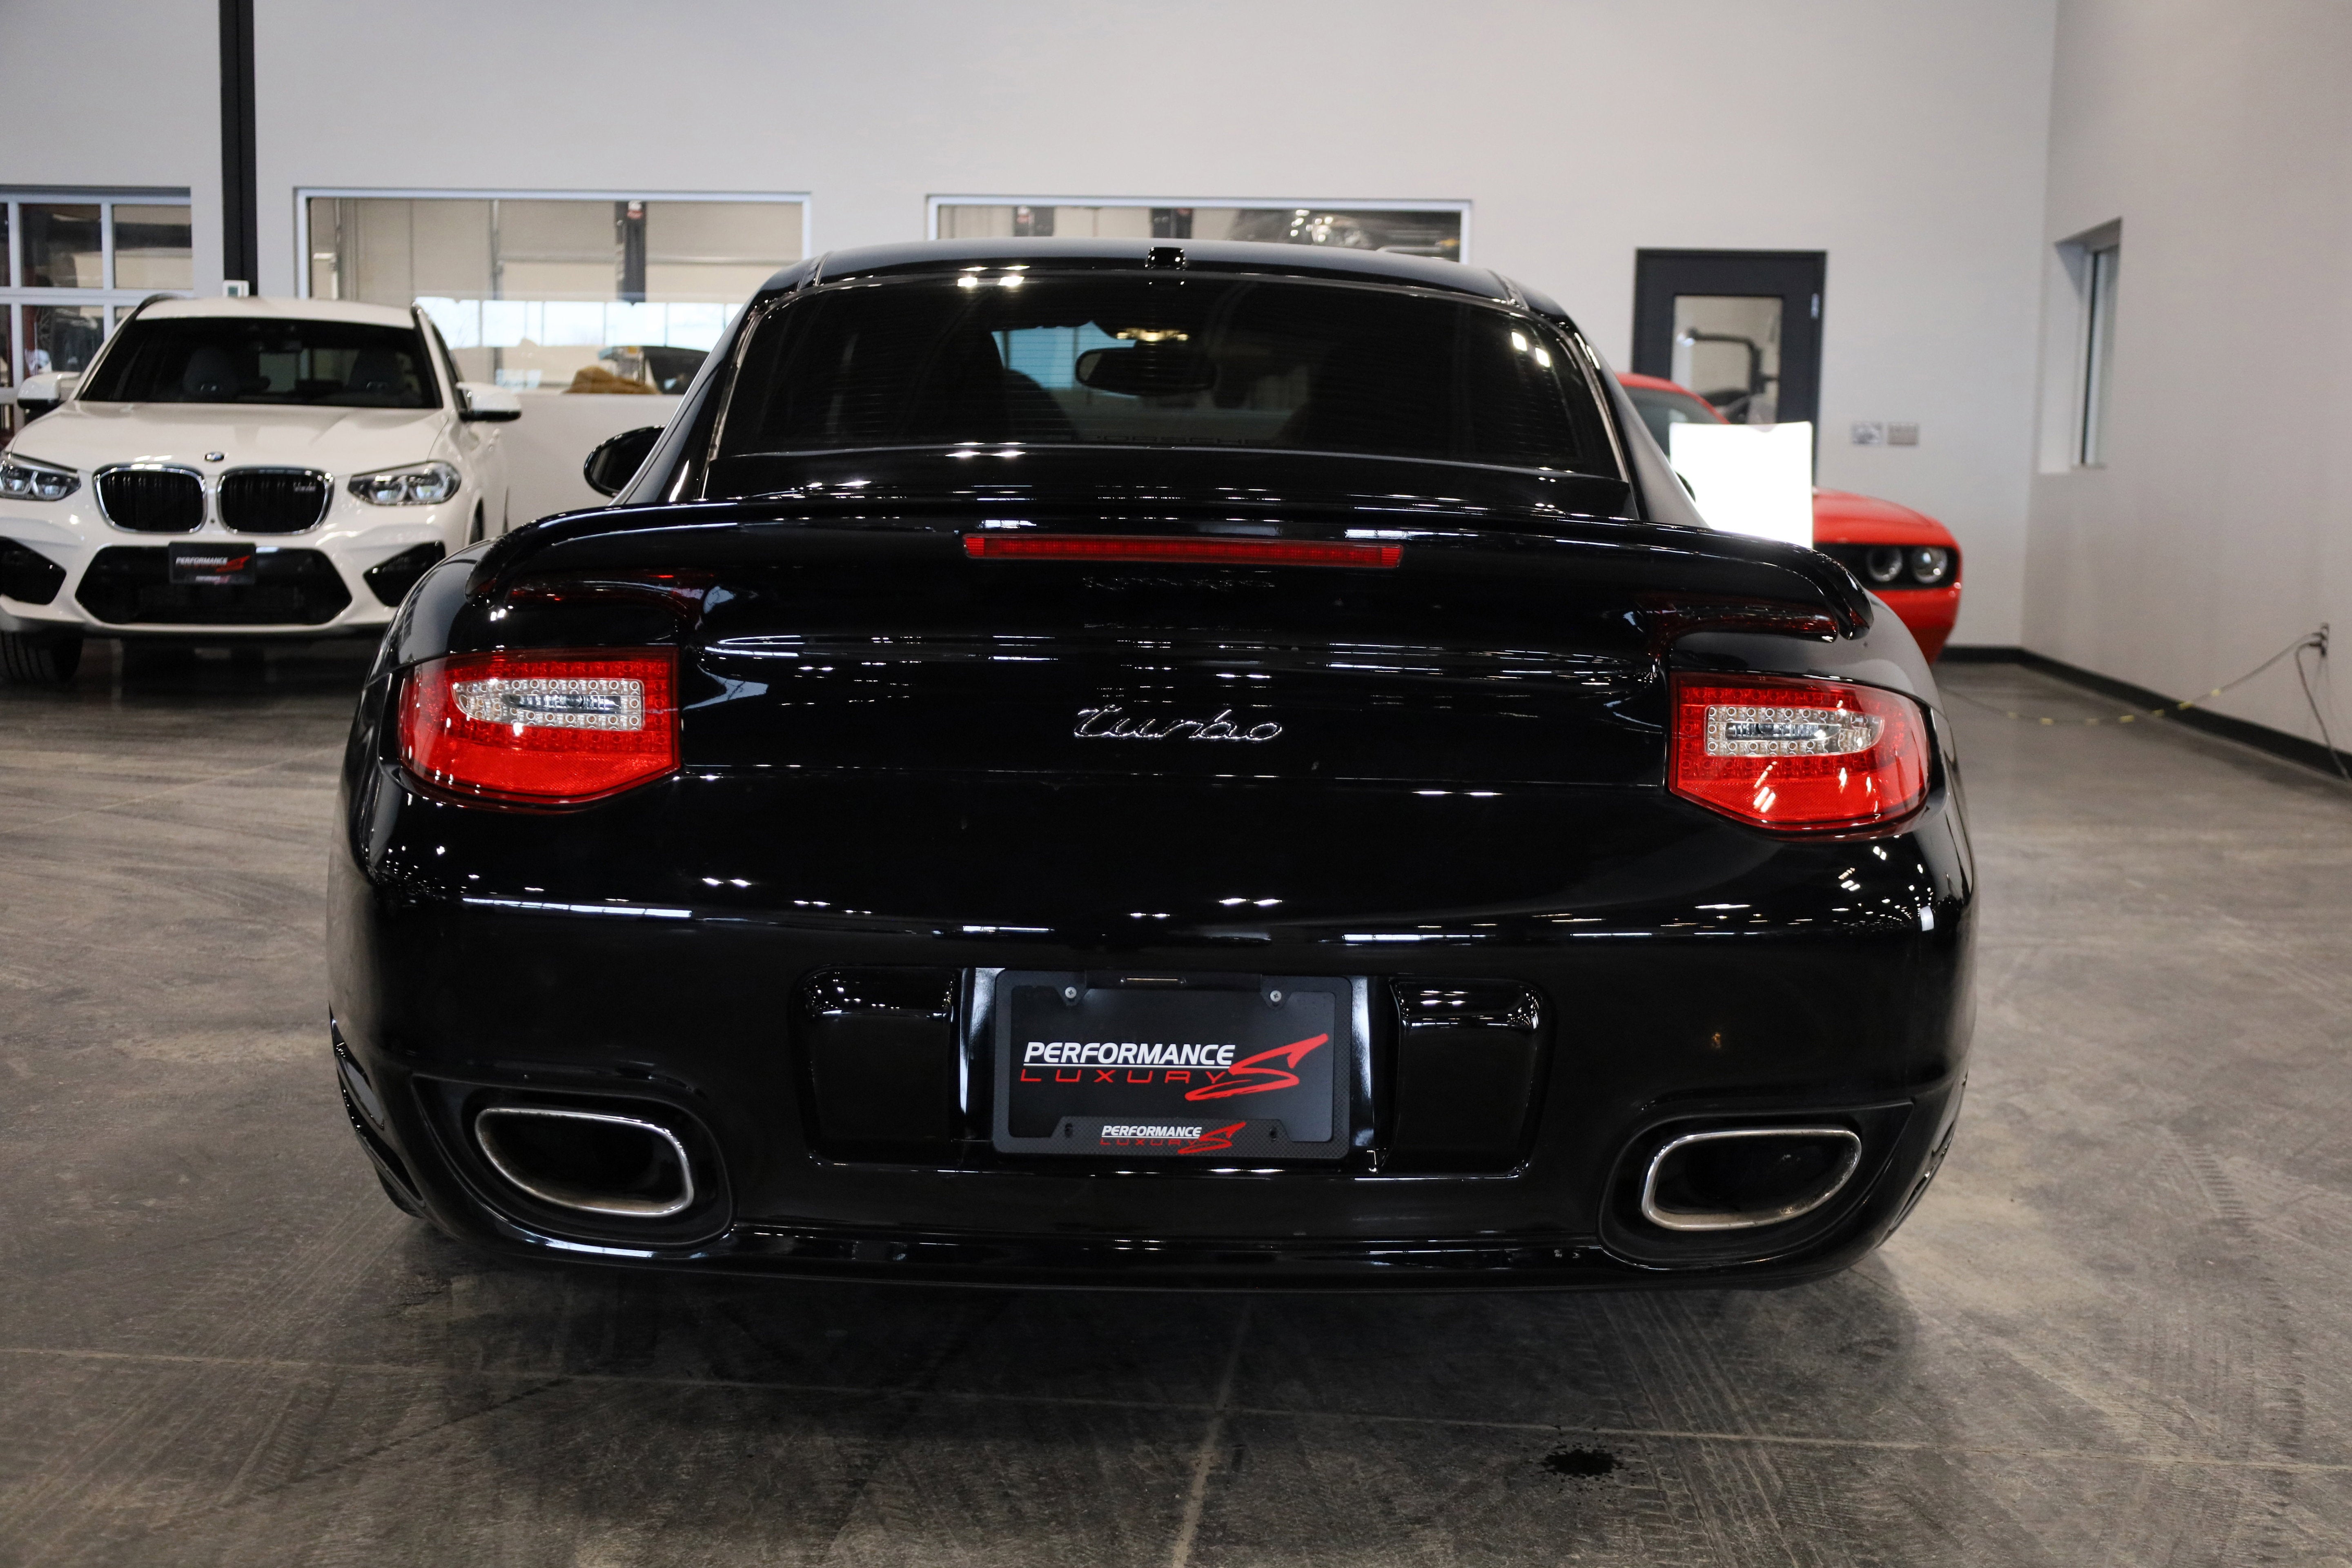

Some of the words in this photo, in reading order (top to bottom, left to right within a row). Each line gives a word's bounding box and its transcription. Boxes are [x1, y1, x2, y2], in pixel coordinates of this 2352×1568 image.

[176, 557, 228, 565] PERFORMANCE
[1074, 704, 1282, 742] turbo
[1024, 1042, 1236, 1065] PERFORMANCE
[1101, 1125, 1202, 1137] PERFORMANCE
